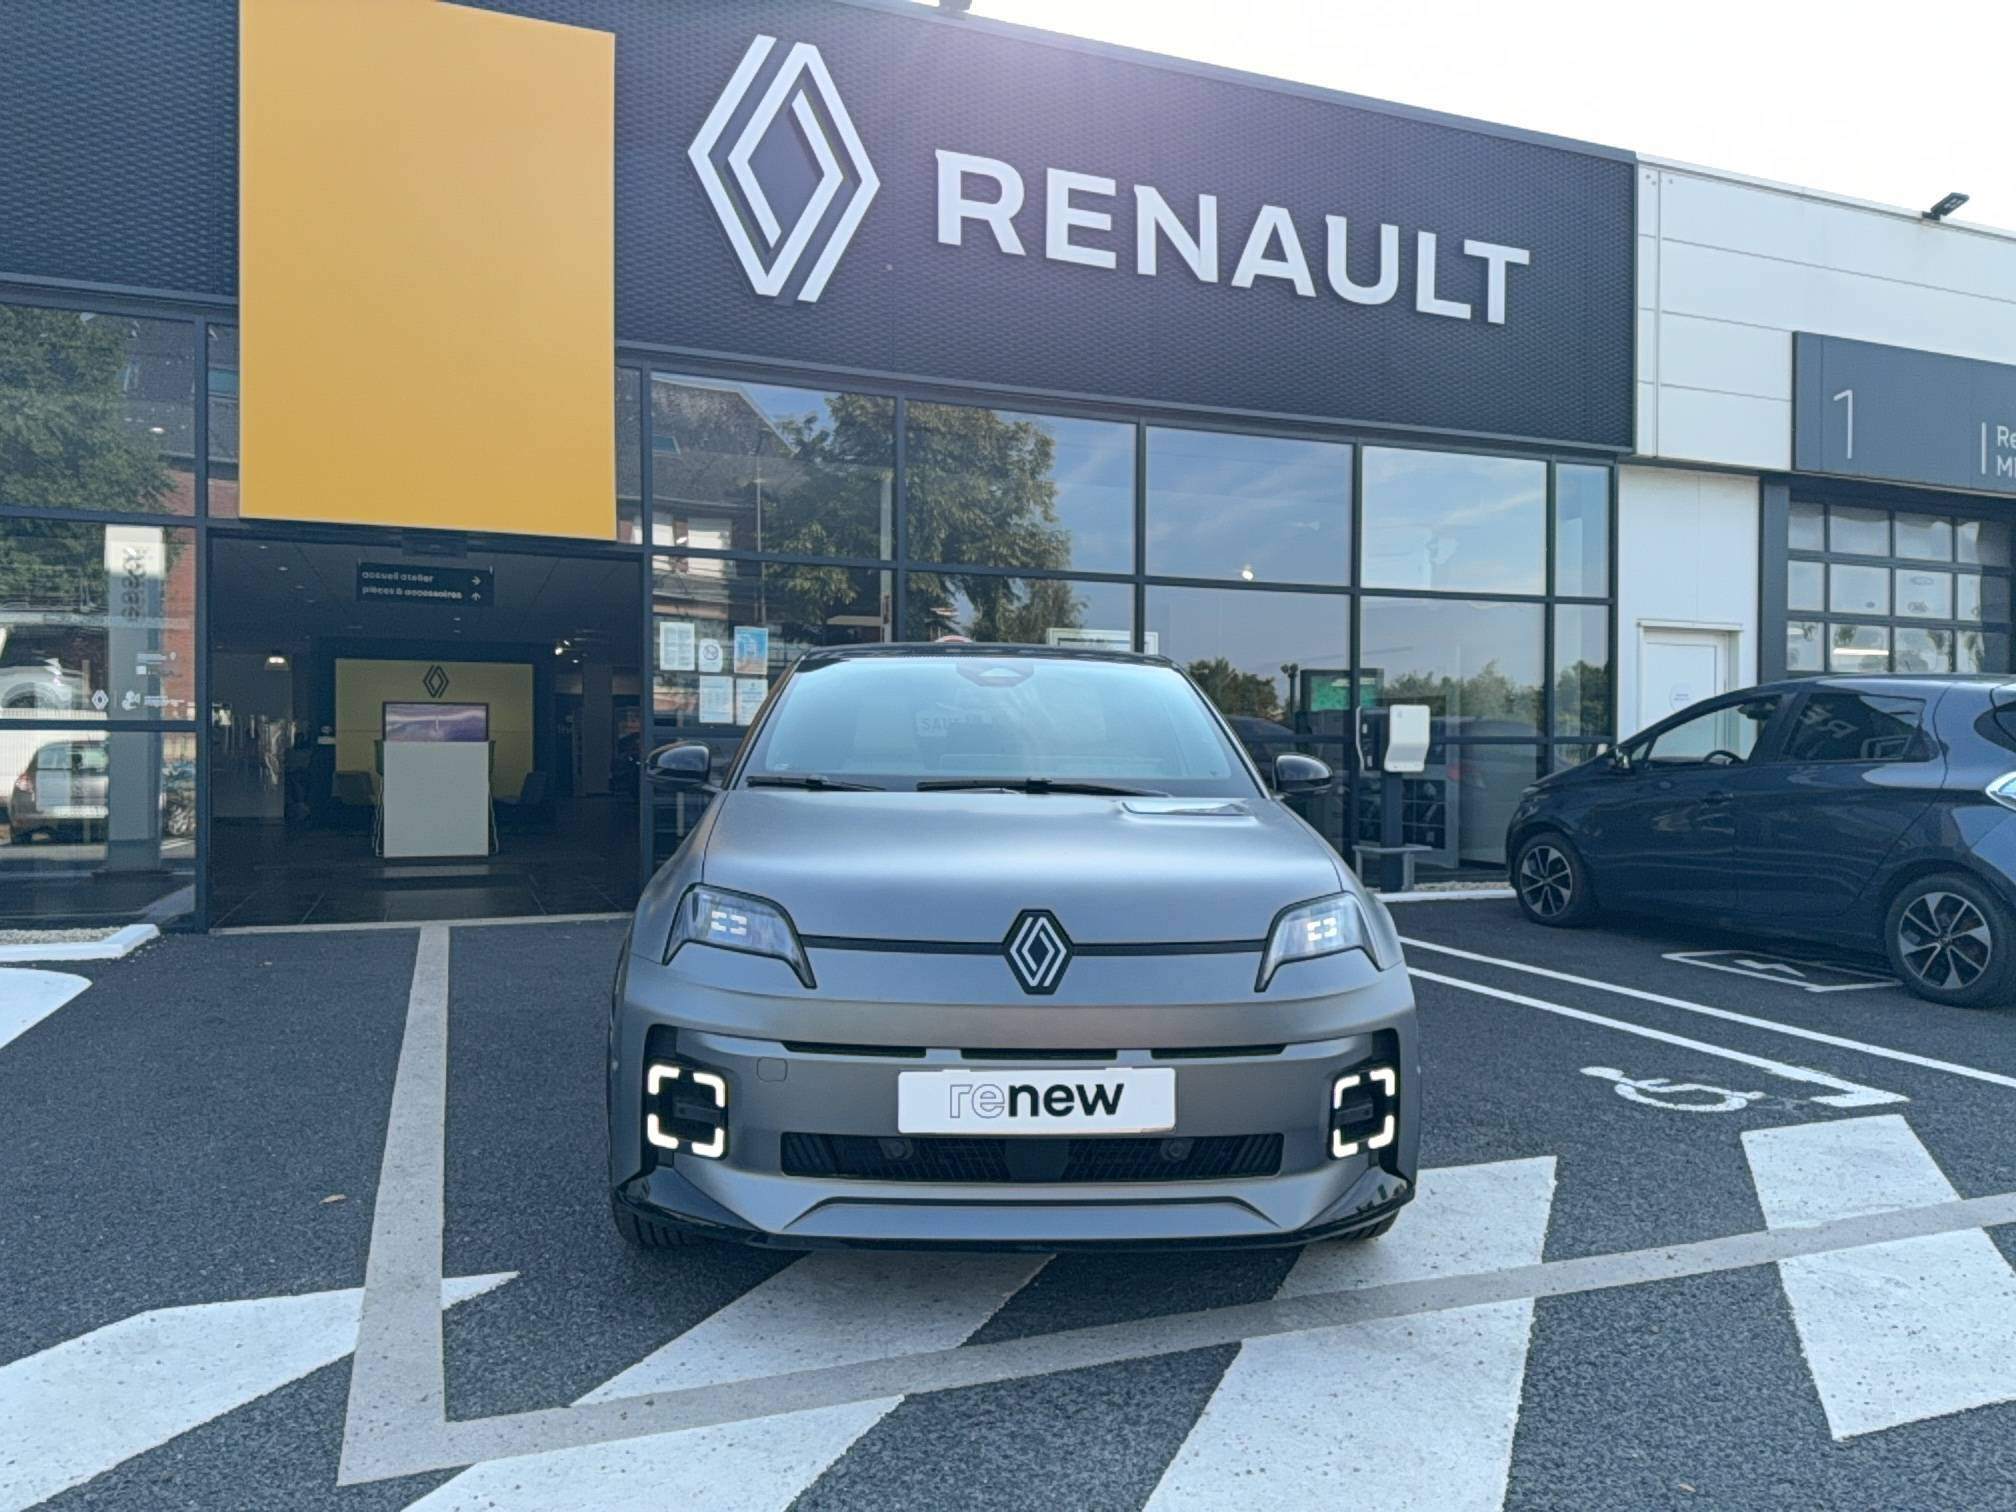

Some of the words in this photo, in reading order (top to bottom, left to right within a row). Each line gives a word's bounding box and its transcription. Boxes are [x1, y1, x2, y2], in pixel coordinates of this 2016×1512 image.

[935, 149, 1530, 325] RENAULT
[1833, 389, 1854, 460] 1
[361, 571, 399, 581] accueil
[400, 573, 434, 583] atelier
[404, 589, 463, 600] accessoires
[949, 1082, 1125, 1119] renew
